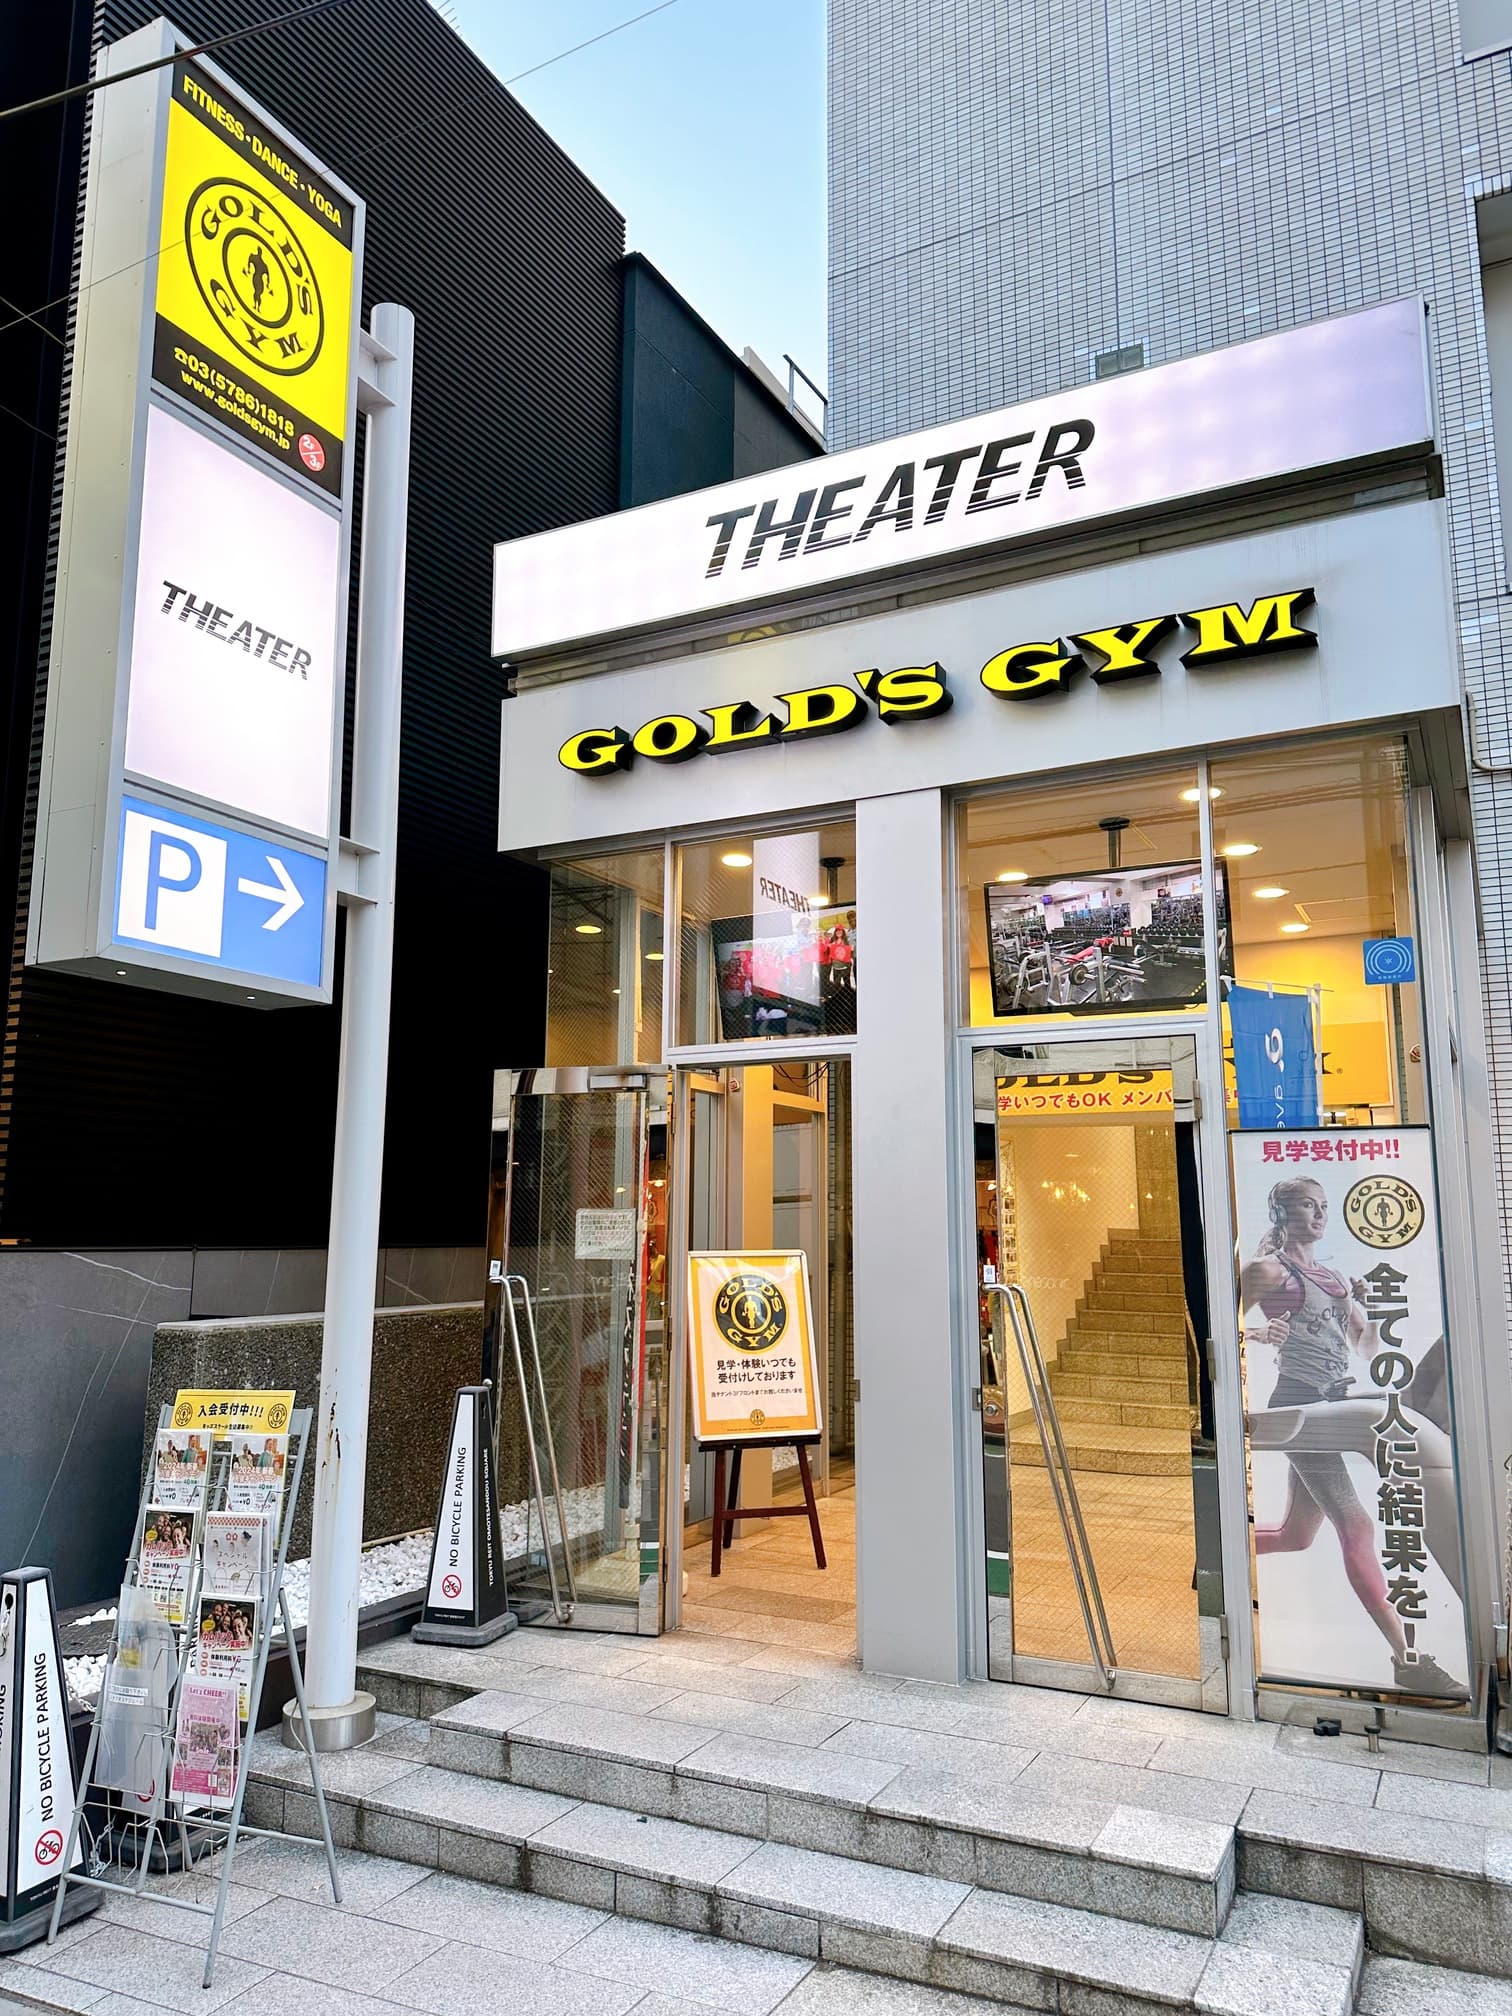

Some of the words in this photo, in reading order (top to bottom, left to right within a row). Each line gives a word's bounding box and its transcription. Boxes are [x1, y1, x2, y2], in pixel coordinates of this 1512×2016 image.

[183, 75, 244, 141] FITNESS
[252, 135, 298, 189] DANCE
[307, 183, 342, 228] YOGA
[201, 195, 313, 316] GOLD'S
[210, 278, 304, 359] GYM
[181, 370, 291, 450] www.goldsgym.jp
[704, 418, 1096, 578] THEATER
[160, 579, 312, 681] THEATER
[557, 662, 952, 774] GOLD'S
[979, 587, 1320, 701] GYM
[144, 830, 202, 931] P
[1262, 1139, 1400, 1163] 見学受付中!!
[1351, 1181, 1417, 1213] GOLD'S
[1358, 1222, 1414, 1243] GYM
[719, 1278, 783, 1314] GOLD'S
[727, 1322, 781, 1347] GYM
[718, 1370, 796, 1384] 受付けしております
[198, 1402, 265, 1418] 入会受付中!!!
[454, 1447, 467, 1497] PARKING
[1363, 1261, 1429, 1664] 全ての人に結果を!
[450, 1501, 463, 1547] BICYCLE
[449, 1550, 459, 1567] NO
[34, 1652, 49, 1720] PARKING
[38, 1724, 51, 1788] BICYCLE
[41, 1791, 53, 1822] NO
